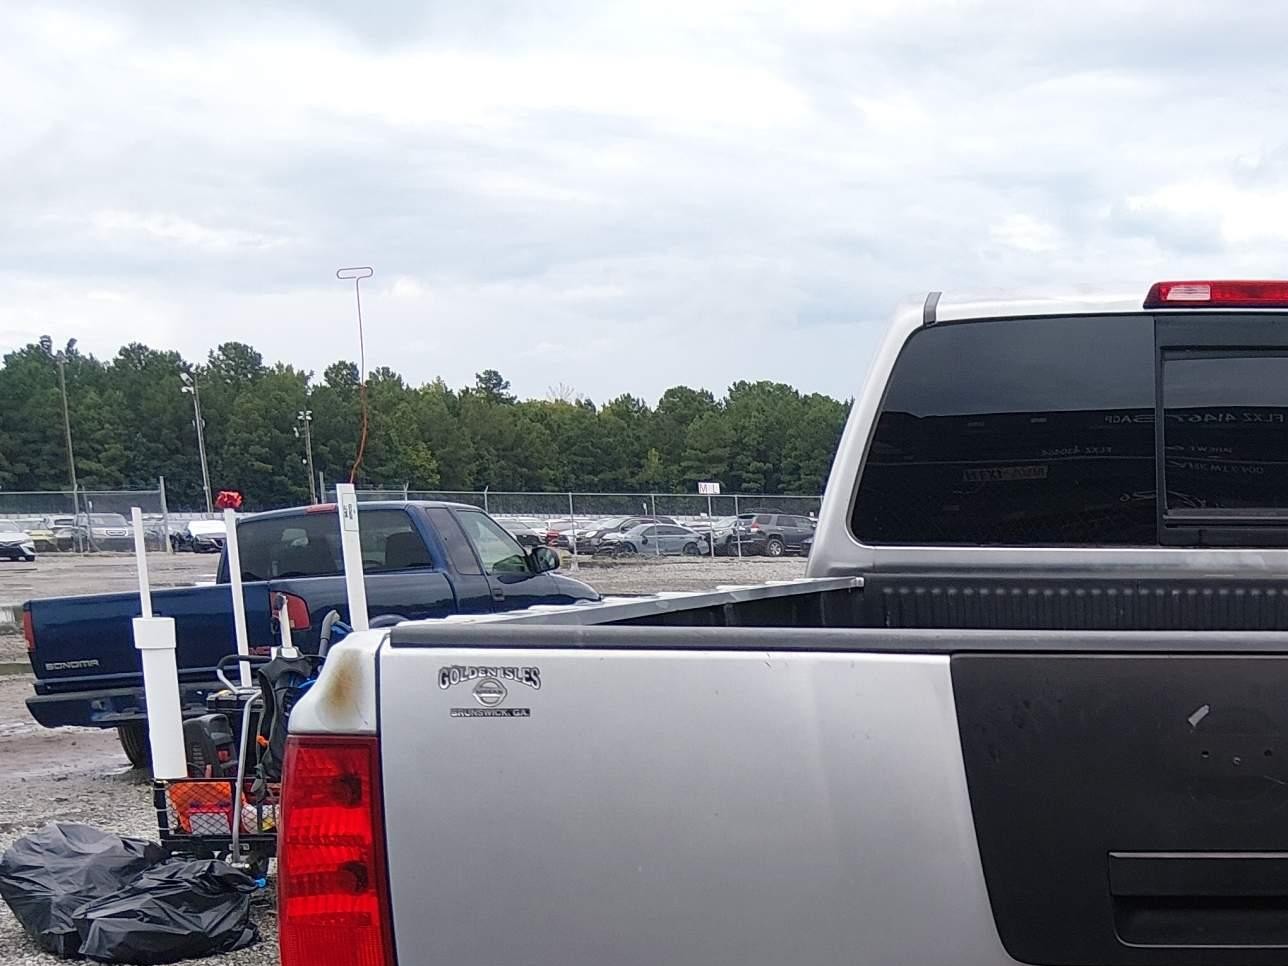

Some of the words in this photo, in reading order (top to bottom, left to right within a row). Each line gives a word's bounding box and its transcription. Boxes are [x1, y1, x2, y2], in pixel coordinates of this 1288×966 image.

[45, 659, 100, 671] SONOMA
[438, 664, 498, 690] GOLDEN
[500, 665, 541, 690] ISLES
